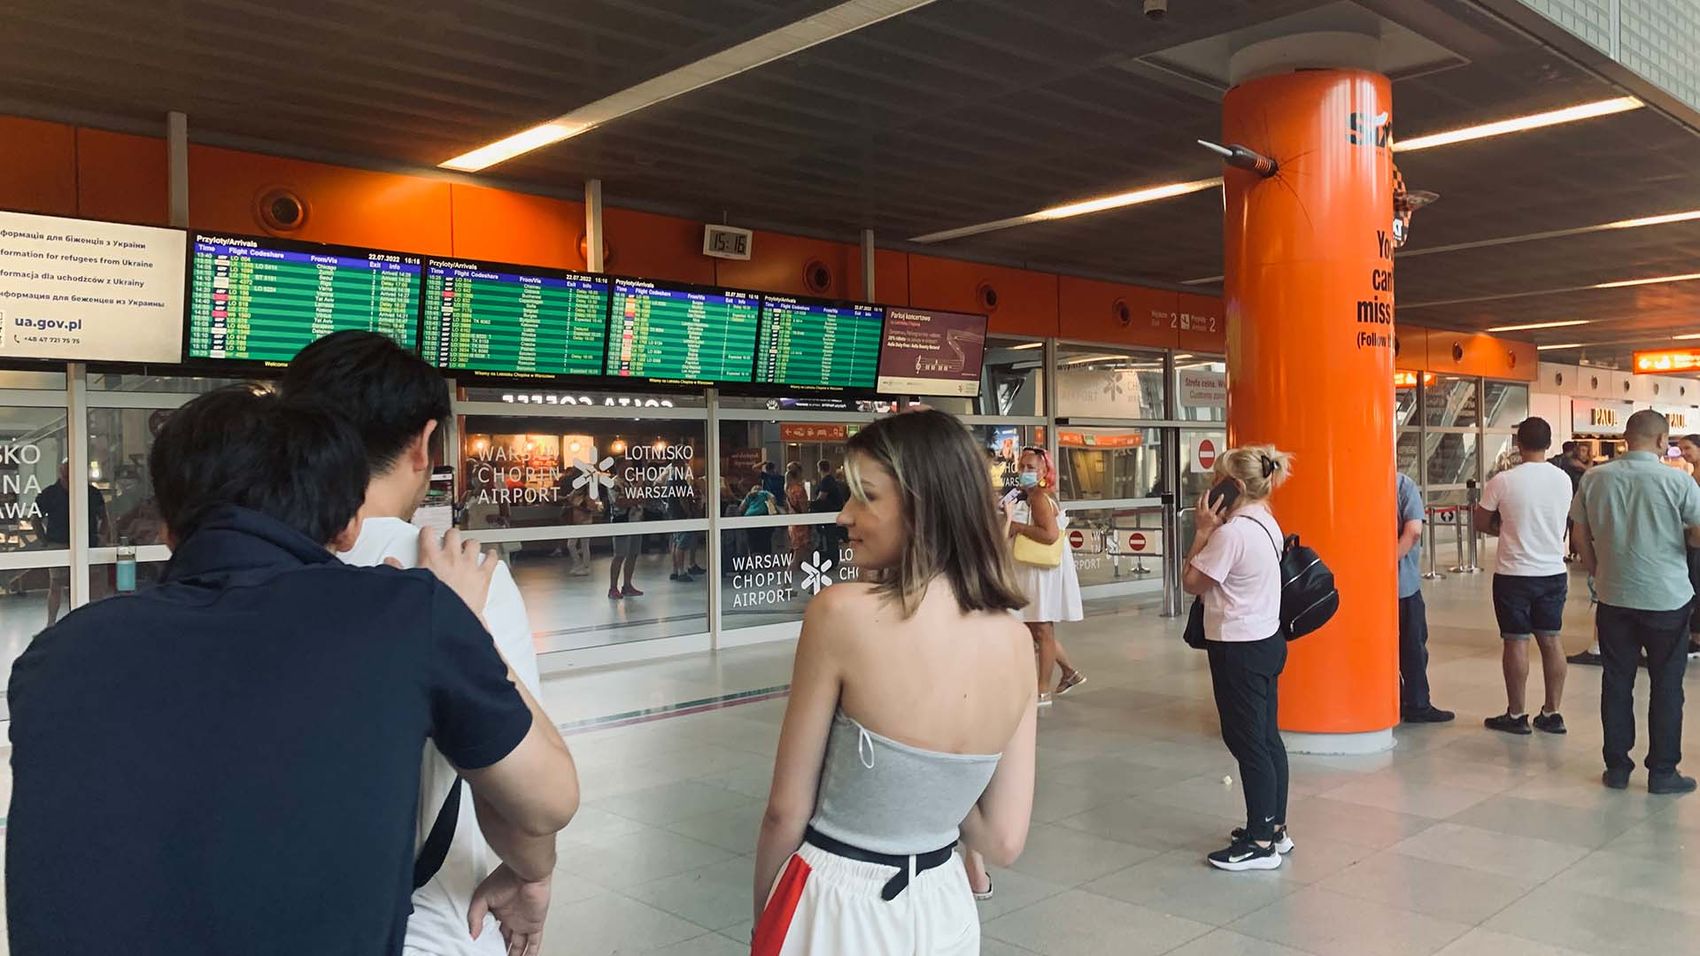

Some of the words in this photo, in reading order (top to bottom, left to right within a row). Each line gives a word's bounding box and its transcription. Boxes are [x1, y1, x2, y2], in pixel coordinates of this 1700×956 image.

[198, 243, 216, 252] Time
[229, 247, 248, 256] Flight
[250, 249, 285, 259] Codeshare
[714, 232, 747, 255] 15:16
[46, 252, 59, 260] for
[60, 254, 98, 263] refugees
[100, 257, 120, 265] from
[122, 259, 154, 268] Ukraine
[430, 267, 444, 275] Time
[113, 277, 145, 288] Ukrainy
[1357, 295, 1391, 325] miss
[15, 318, 82, 332] ua.gov.pl
[1170, 312, 1177, 329] 2
[1209, 316, 1216, 332] 2
[624, 445, 694, 460] LOTNISKO
[478, 466, 560, 484] CHOPIN
[478, 487, 561, 504] AIRPORT
[624, 485, 695, 500] WARSZAWA
[732, 552, 793, 572] WARSAW
[732, 570, 793, 590] CHOPIN
[732, 588, 793, 608] AIRPORT
